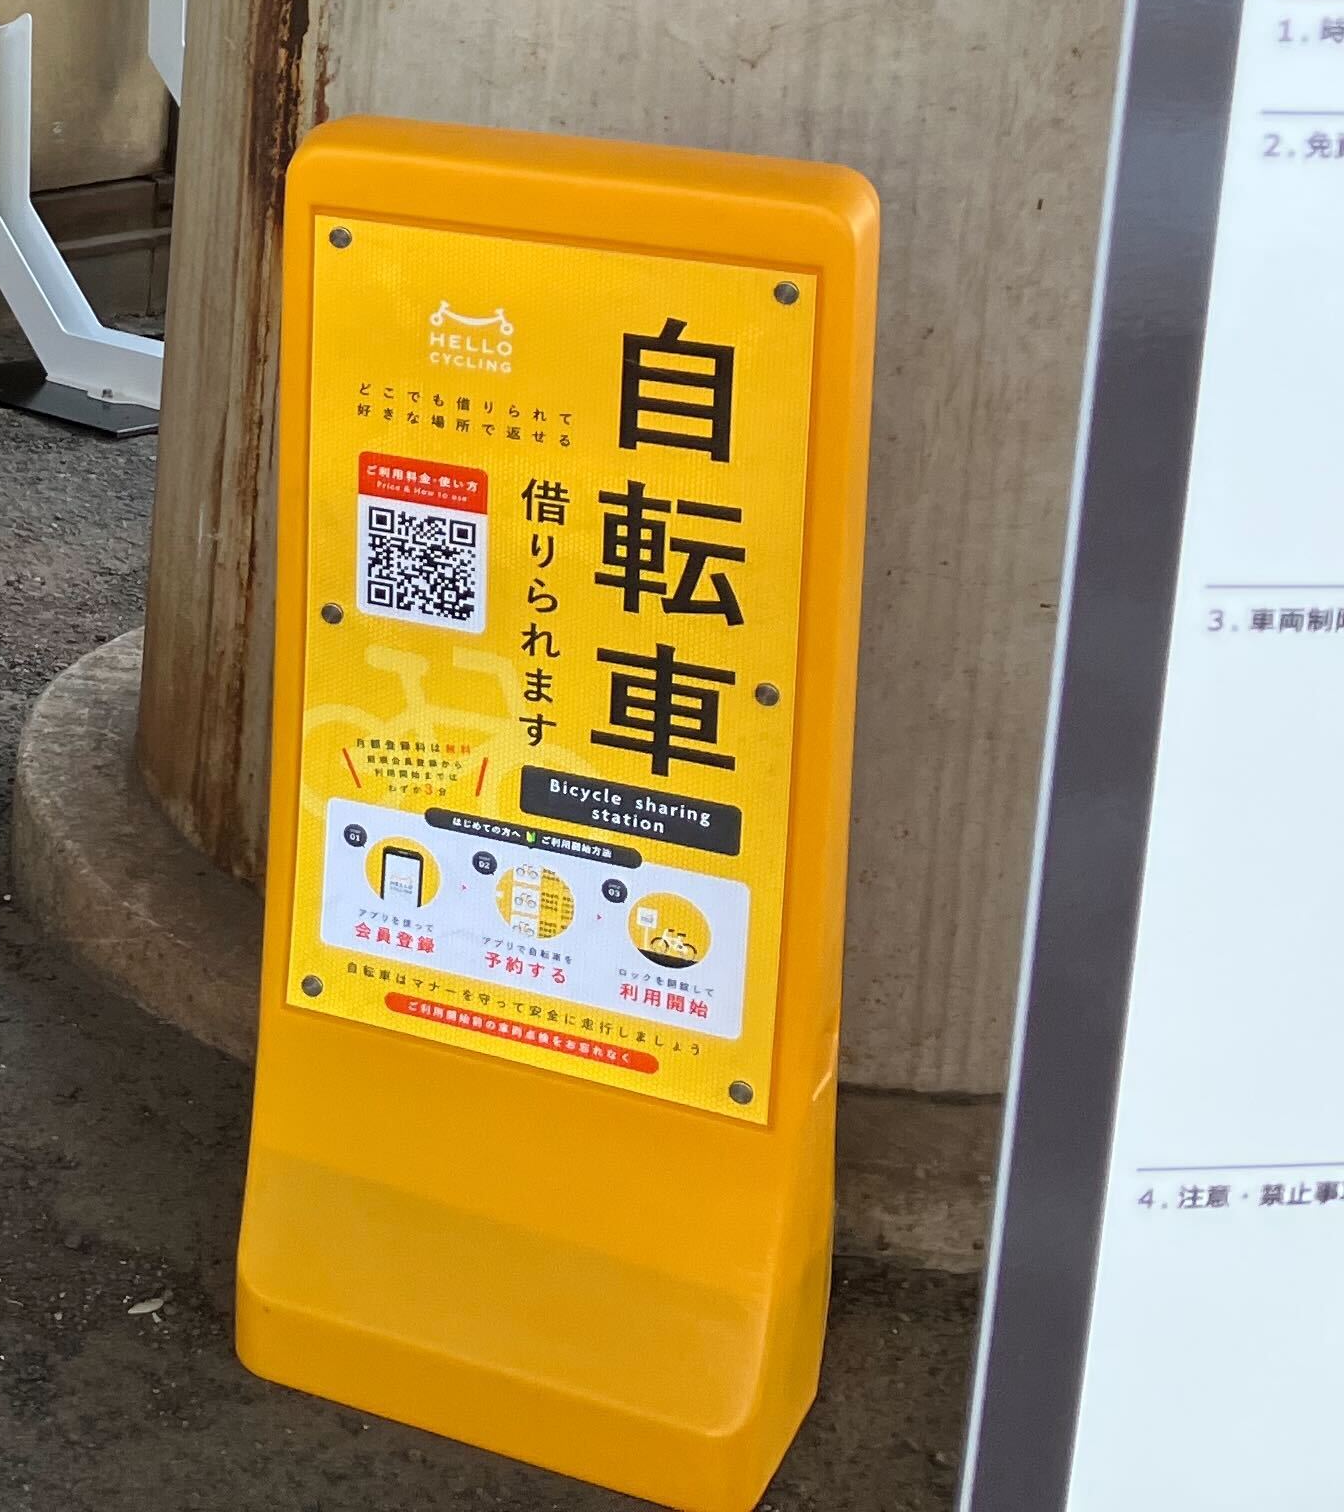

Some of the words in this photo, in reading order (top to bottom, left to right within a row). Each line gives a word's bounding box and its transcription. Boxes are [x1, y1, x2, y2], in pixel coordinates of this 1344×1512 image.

[429, 333, 512, 356] HELLO
[429, 352, 512, 373] CYCLING
[359, 383, 573, 426] どこでも借りられて
[357, 403, 572, 447] 好きな場所で返せる
[590, 317, 746, 778] 自転車
[518, 478, 571, 748] 借りられます
[549, 778, 622, 807] Bicycle
[634, 796, 711, 828] sharing
[349, 832, 361, 842] 01
[451, 816, 522, 839] はじめての方へ
[591, 808, 665, 834] station
[478, 859, 491, 870] 02
[608, 888, 621, 899] 03
[354, 921, 436, 955] 会員登録
[484, 951, 567, 985] 予約する
[619, 982, 710, 1020] 利用開始
[1136, 1180, 1344, 1210] 4.注意・禁止事
